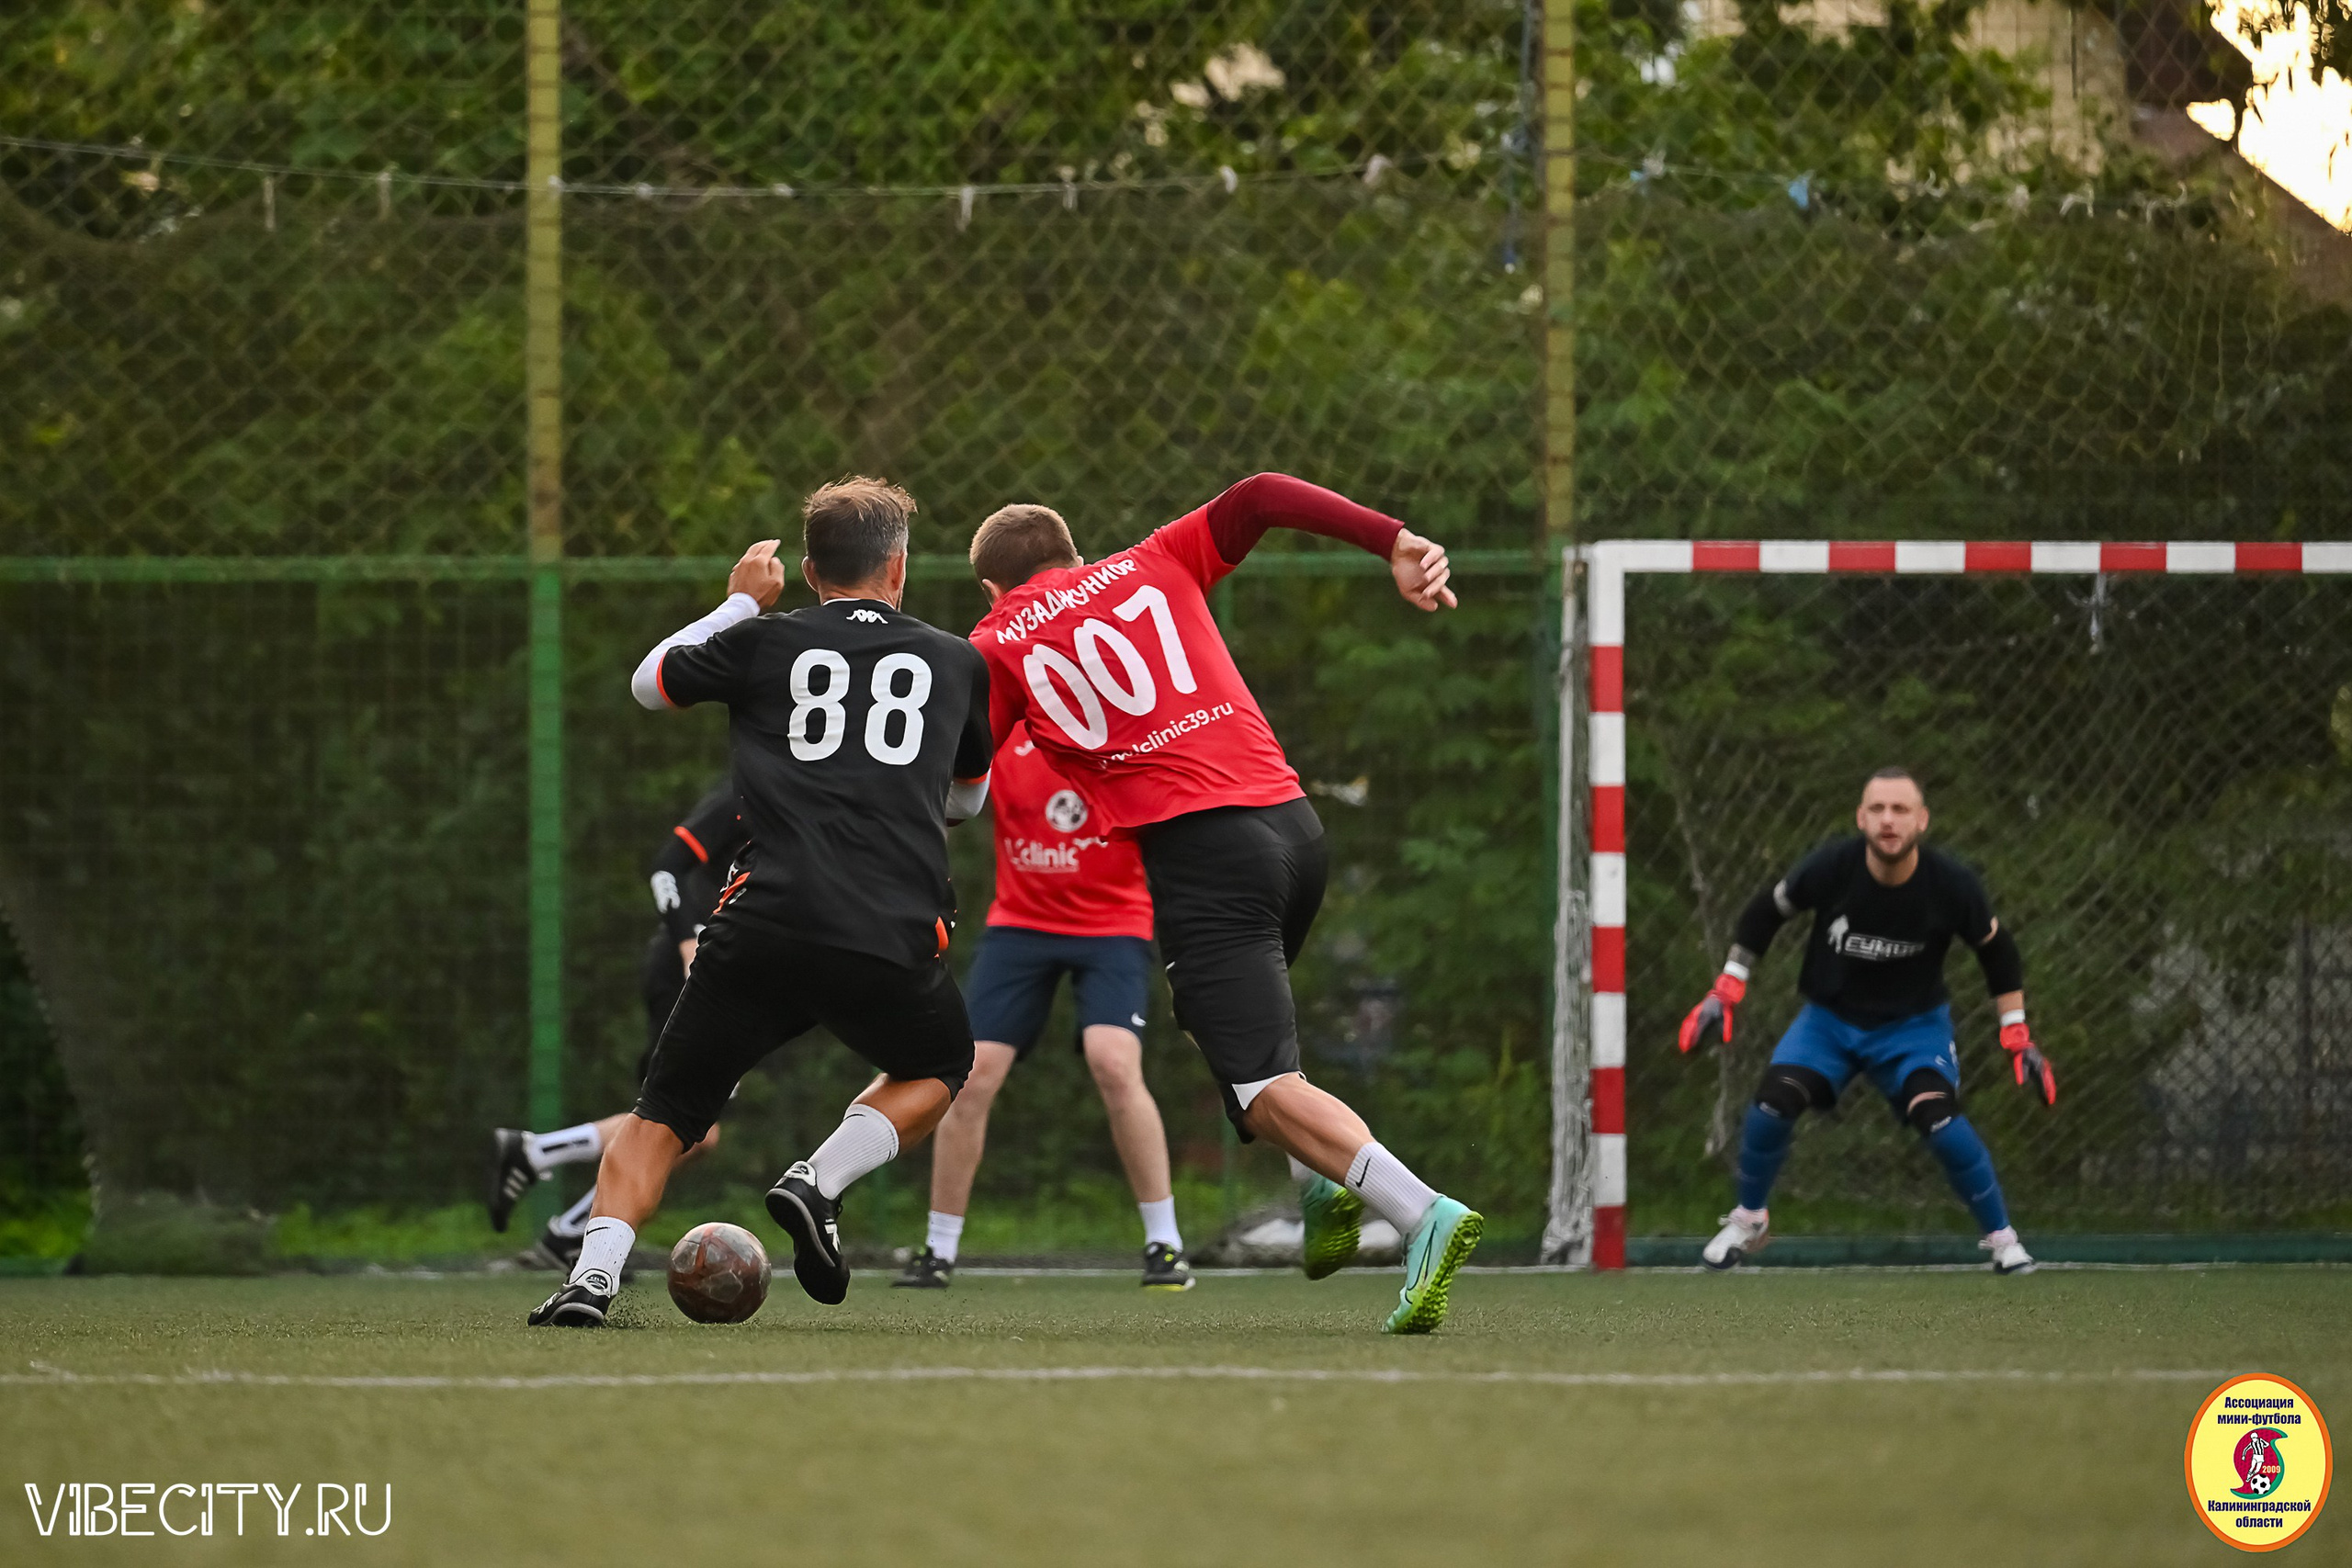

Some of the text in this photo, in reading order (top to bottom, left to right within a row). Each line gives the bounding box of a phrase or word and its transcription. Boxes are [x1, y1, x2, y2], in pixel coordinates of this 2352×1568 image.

[996, 558, 1137, 645] МУЗАДЖУНИОР
[787, 649, 933, 765] 88
[1023, 584, 1198, 750] 007
